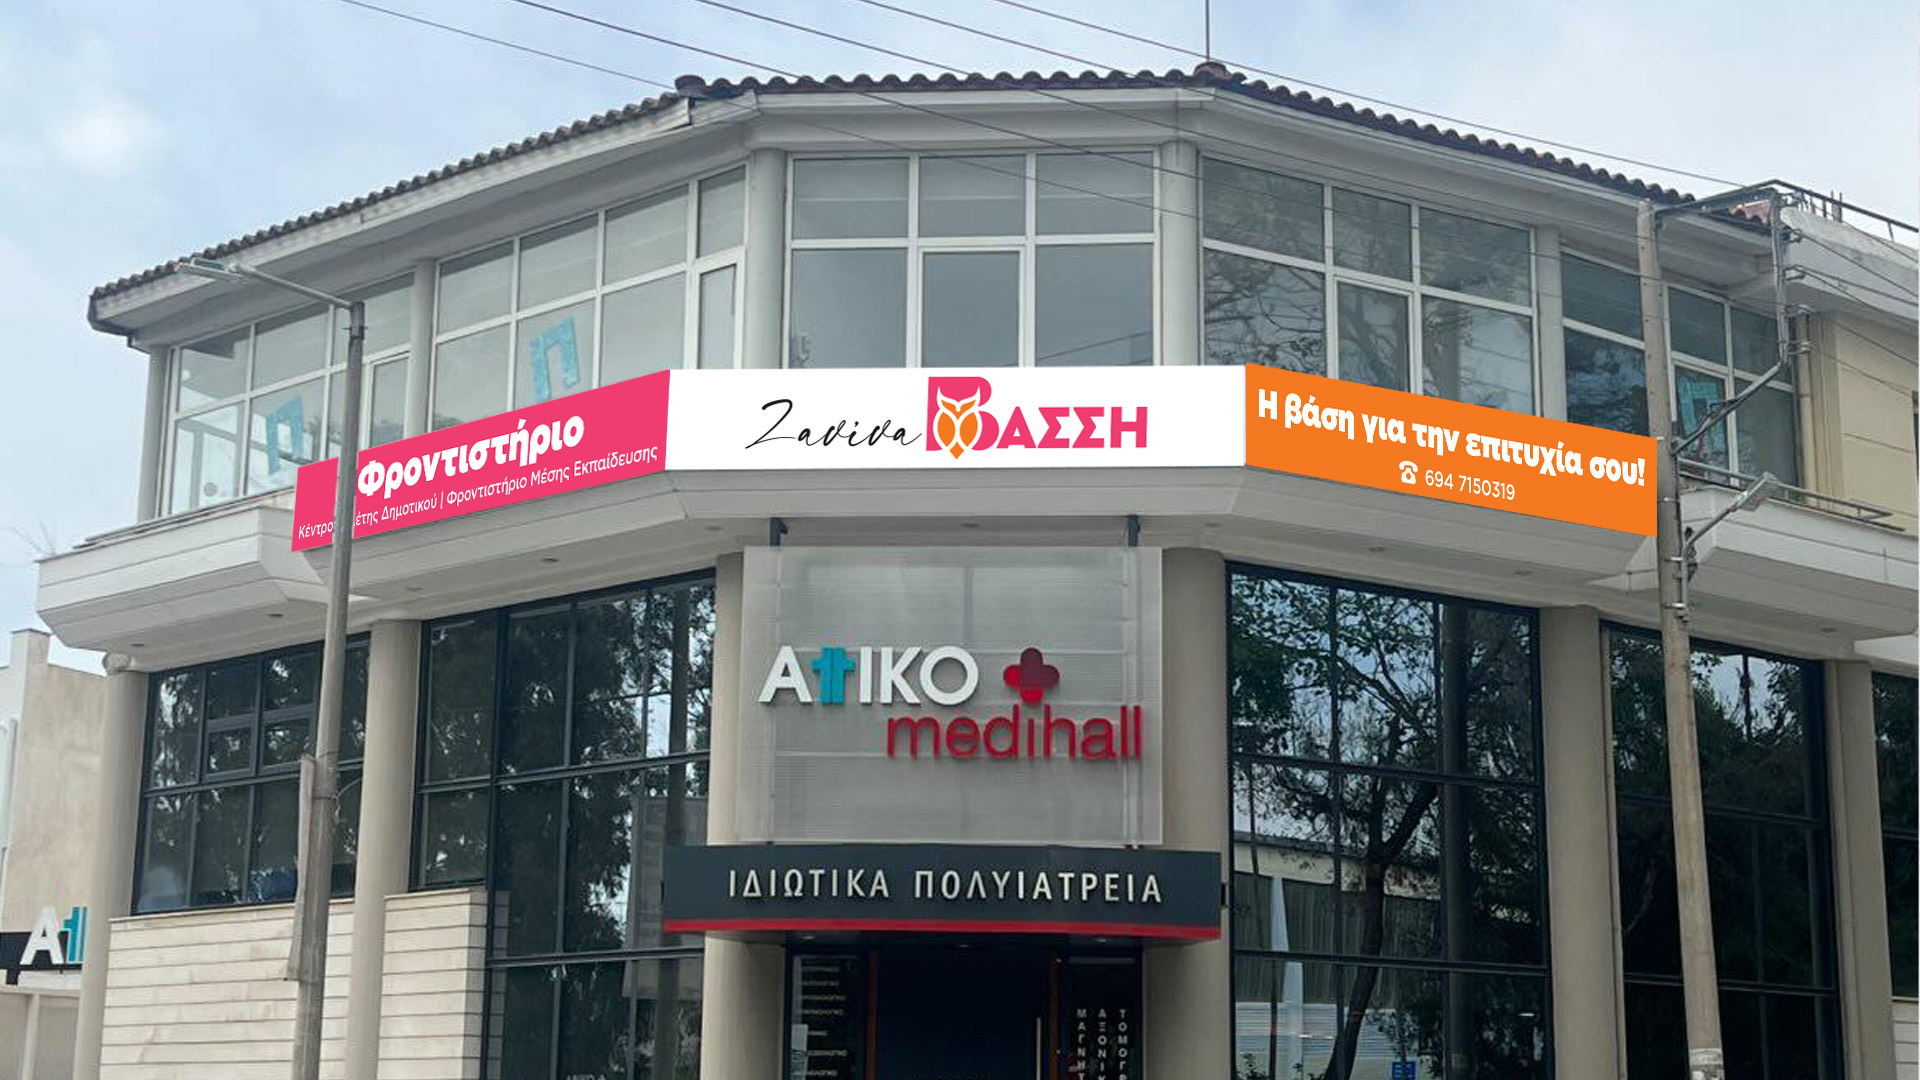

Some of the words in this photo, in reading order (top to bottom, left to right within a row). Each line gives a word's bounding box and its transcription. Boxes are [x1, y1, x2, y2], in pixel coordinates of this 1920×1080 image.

[926, 376, 1148, 451] ΒΑΣΣΗ
[1258, 388, 1278, 420] Η
[1285, 393, 1355, 441] βάση
[1361, 413, 1407, 444] για
[1411, 422, 1461, 457] την
[1465, 432, 1584, 477] επιτυχία
[1589, 456, 1646, 487] σου!
[357, 415, 585, 499] Φροντιστήριο
[381, 492, 438, 521] Δημοτικού
[446, 477, 528, 506] Φροντιστήριο
[530, 466, 570, 487] Μέσης
[573, 446, 658, 477] Εκπαίδευσης
[1425, 469, 1454, 490] 694
[1458, 474, 1516, 500] 7150319
[887, 705, 1143, 760] medihall
[729, 868, 889, 898] ΙΔΙΩΤΙΚΑ
[915, 870, 1161, 903] ΠΟΛΥΙΑΤΡΕΙΑ
